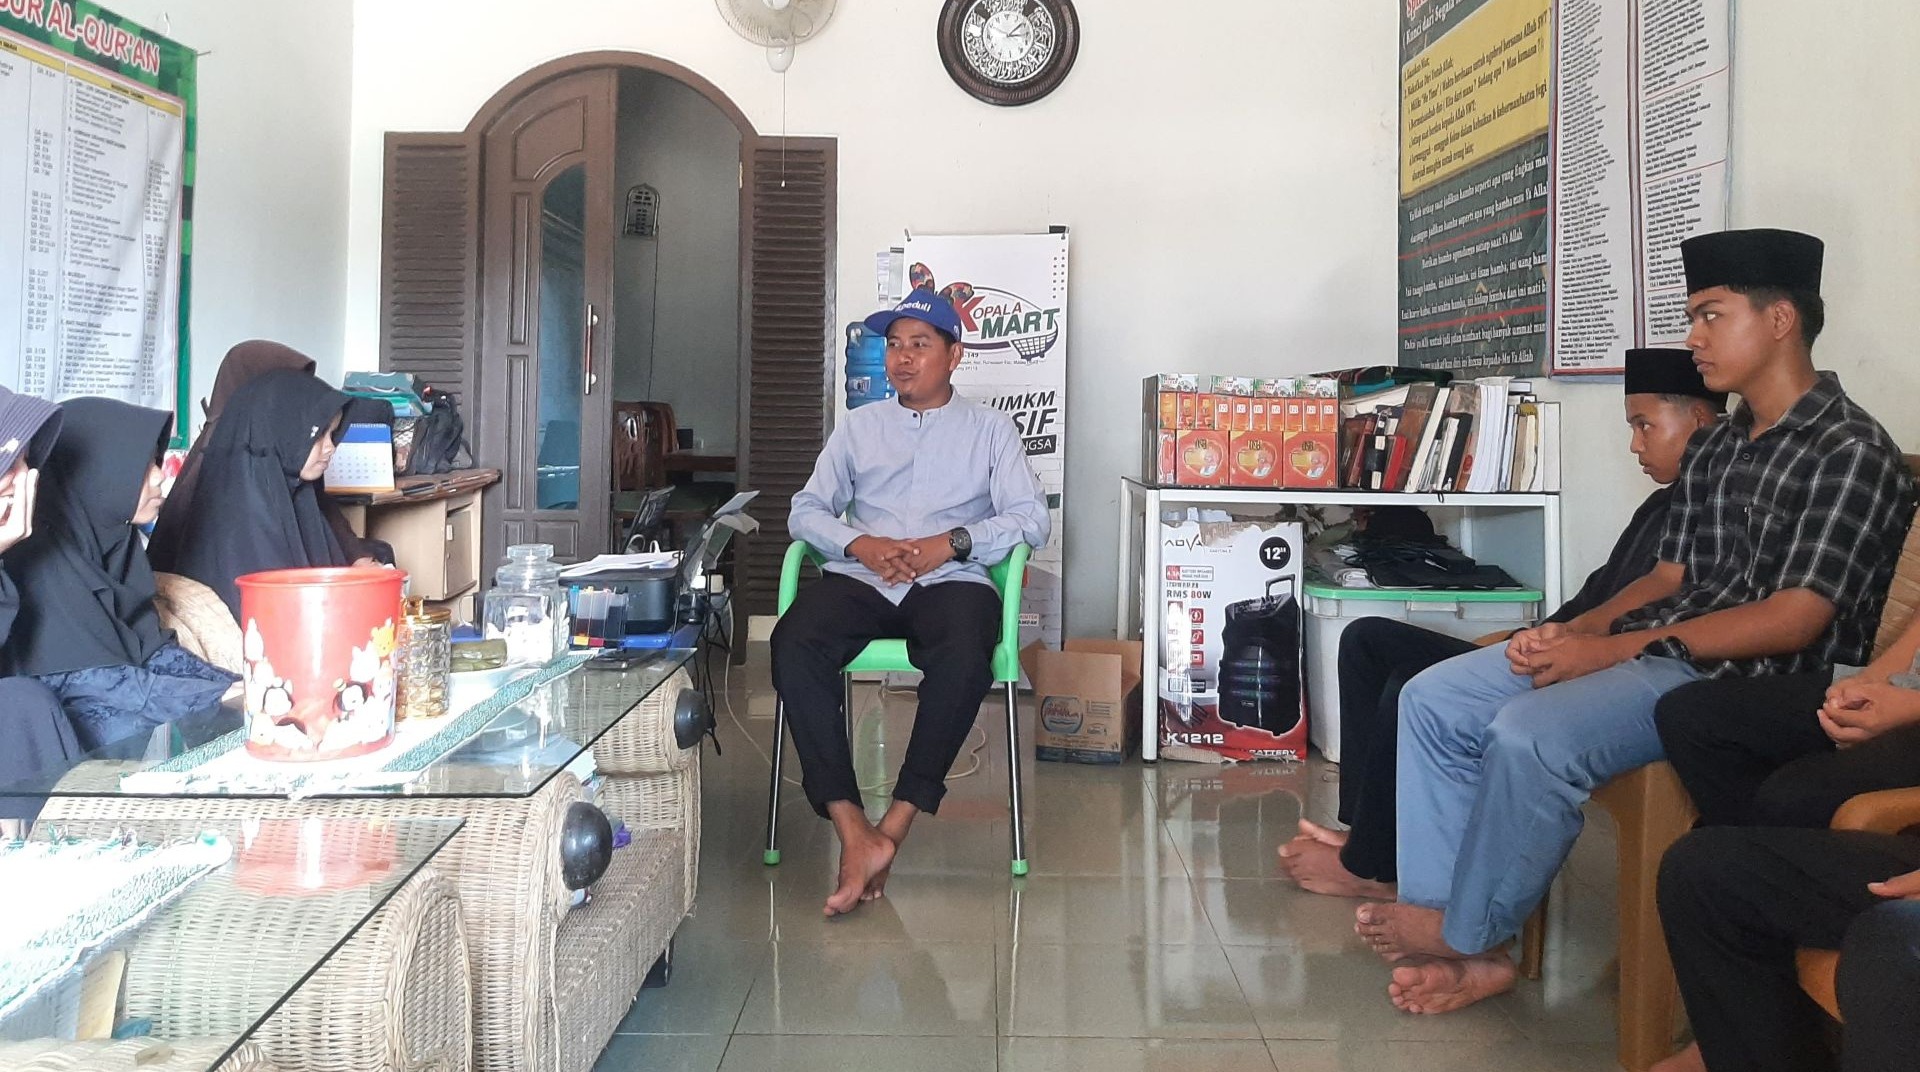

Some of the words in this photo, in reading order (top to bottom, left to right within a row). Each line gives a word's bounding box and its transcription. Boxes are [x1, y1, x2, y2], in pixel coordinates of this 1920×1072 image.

[1422, 9, 1434, 31] dari
[46, 0, 159, 75] AL-QUR'AN
[1503, 31, 1522, 52] bersama
[1524, 19, 1536, 37] Allah
[1478, 72, 1493, 89] Sedang
[1536, 79, 1547, 98] bagi
[1455, 105, 1465, 121] Allah
[1492, 175, 1501, 189] apa
[1502, 169, 1514, 185] yang
[1515, 160, 1534, 178] Engkau
[1483, 204, 1494, 220] yang
[1495, 195, 1512, 211] hamba
[1509, 227, 1523, 242] Allah
[1507, 286, 1517, 299] dan
[1527, 280, 1540, 295] mati
[981, 308, 1060, 340] MART
[1482, 327, 1492, 342] bagi
[1493, 324, 1511, 340] banyak
[991, 390, 1055, 411] UMKM
[1011, 408, 1058, 435] SIF
[1024, 439, 1052, 451] GSA
[1263, 546, 1287, 560] 12"
[1166, 589, 1188, 599] RMS
[1190, 590, 1212, 599] 80W
[1166, 732, 1224, 744] K1212
